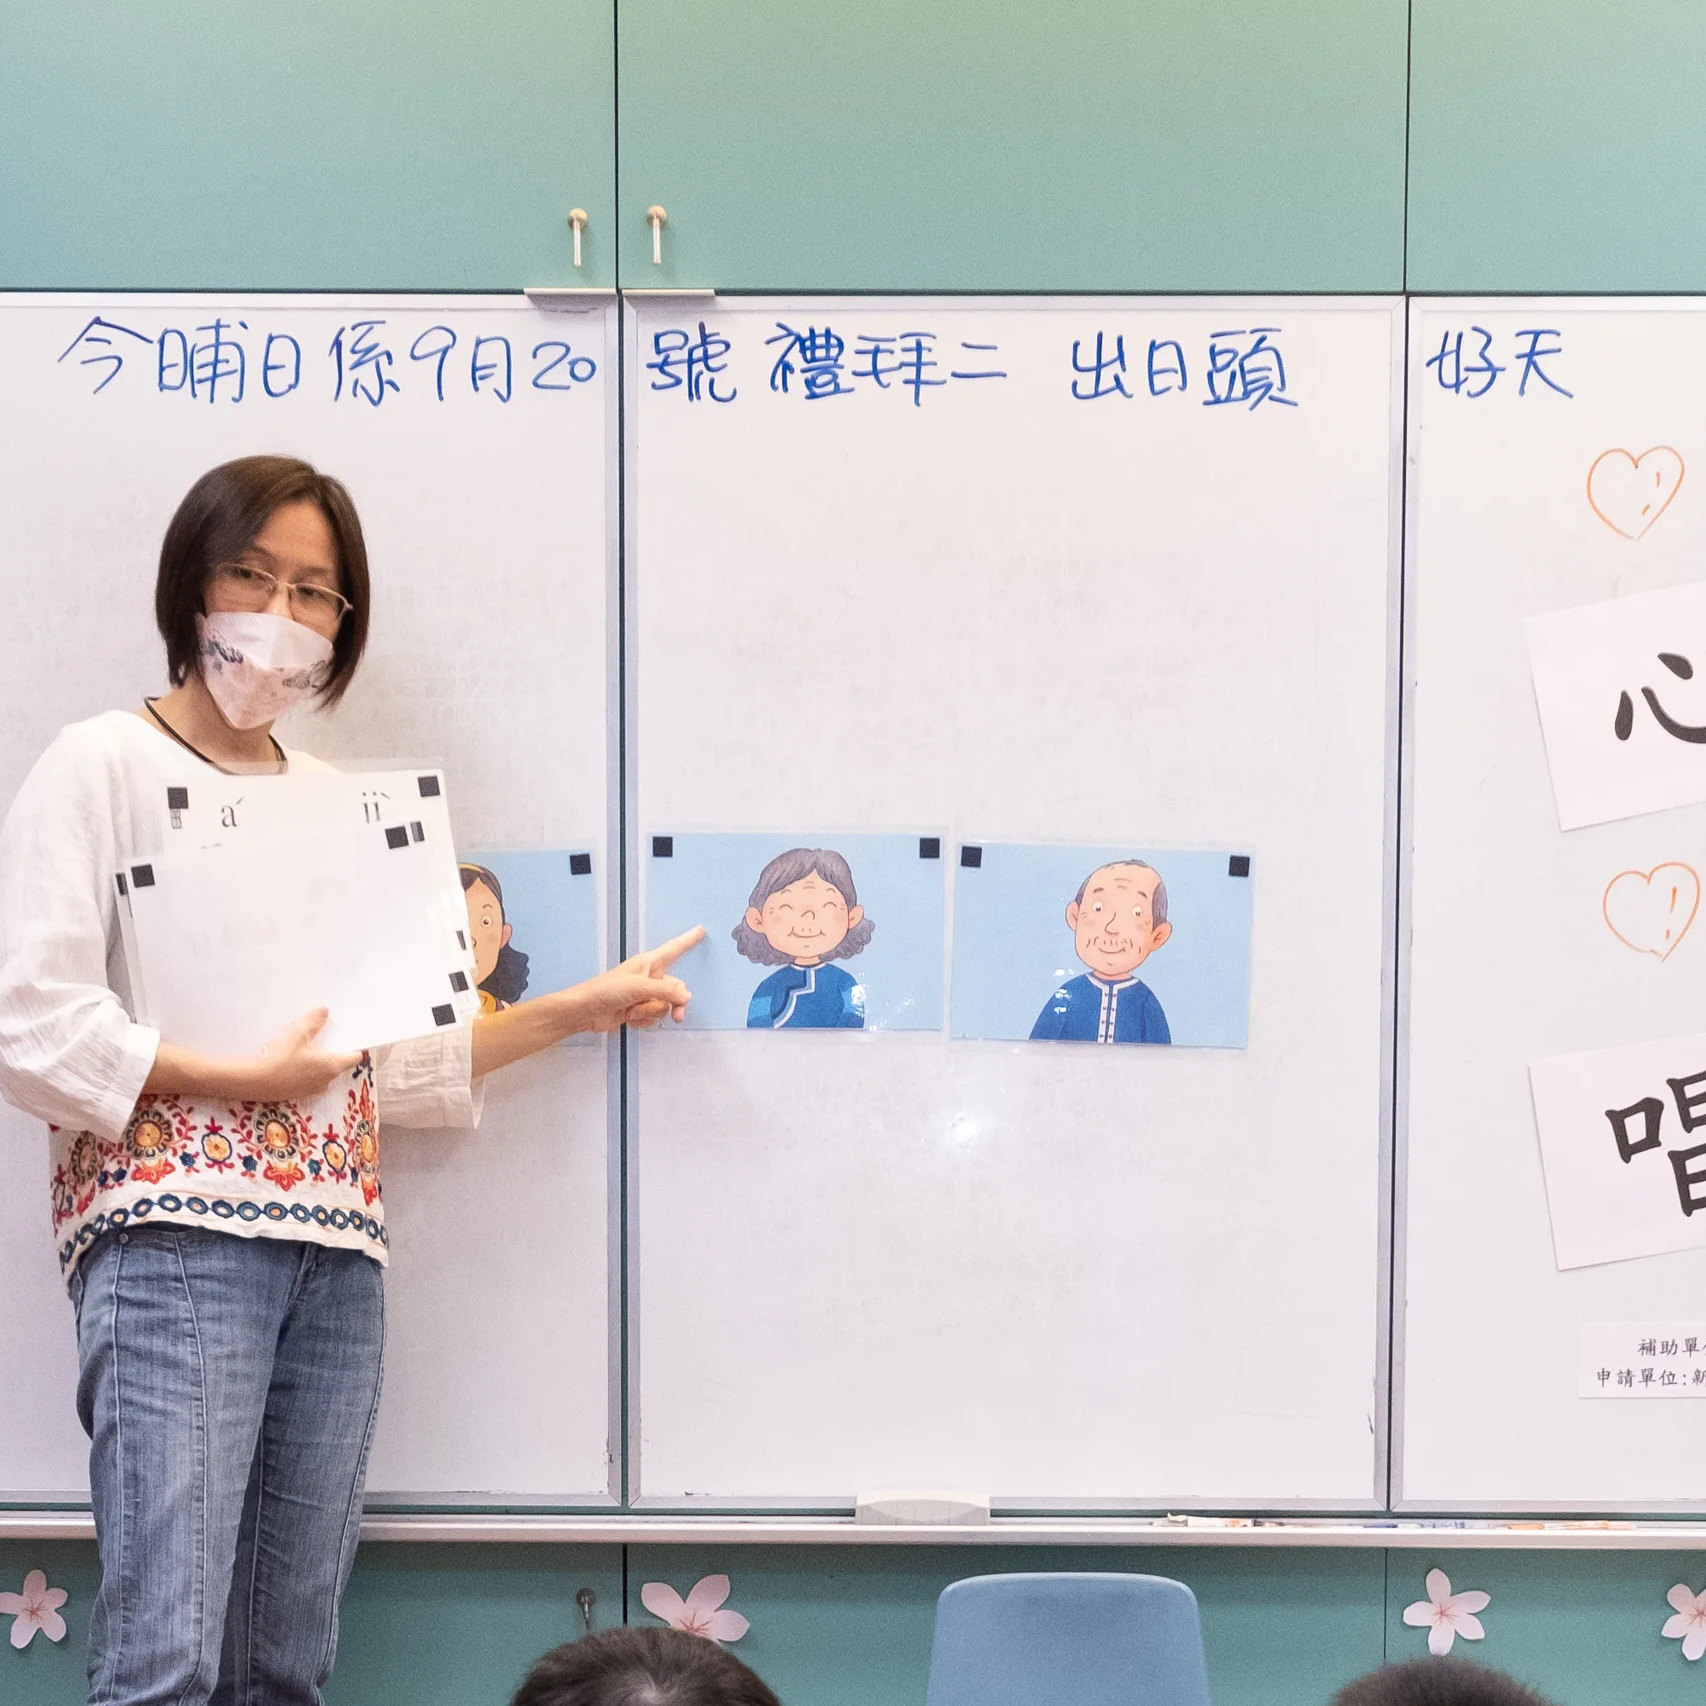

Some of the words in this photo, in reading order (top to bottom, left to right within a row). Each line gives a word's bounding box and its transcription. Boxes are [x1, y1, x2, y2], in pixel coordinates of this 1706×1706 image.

[1071, 328, 1299, 410] 出日頭
[1425, 326, 1574, 399] 好天
